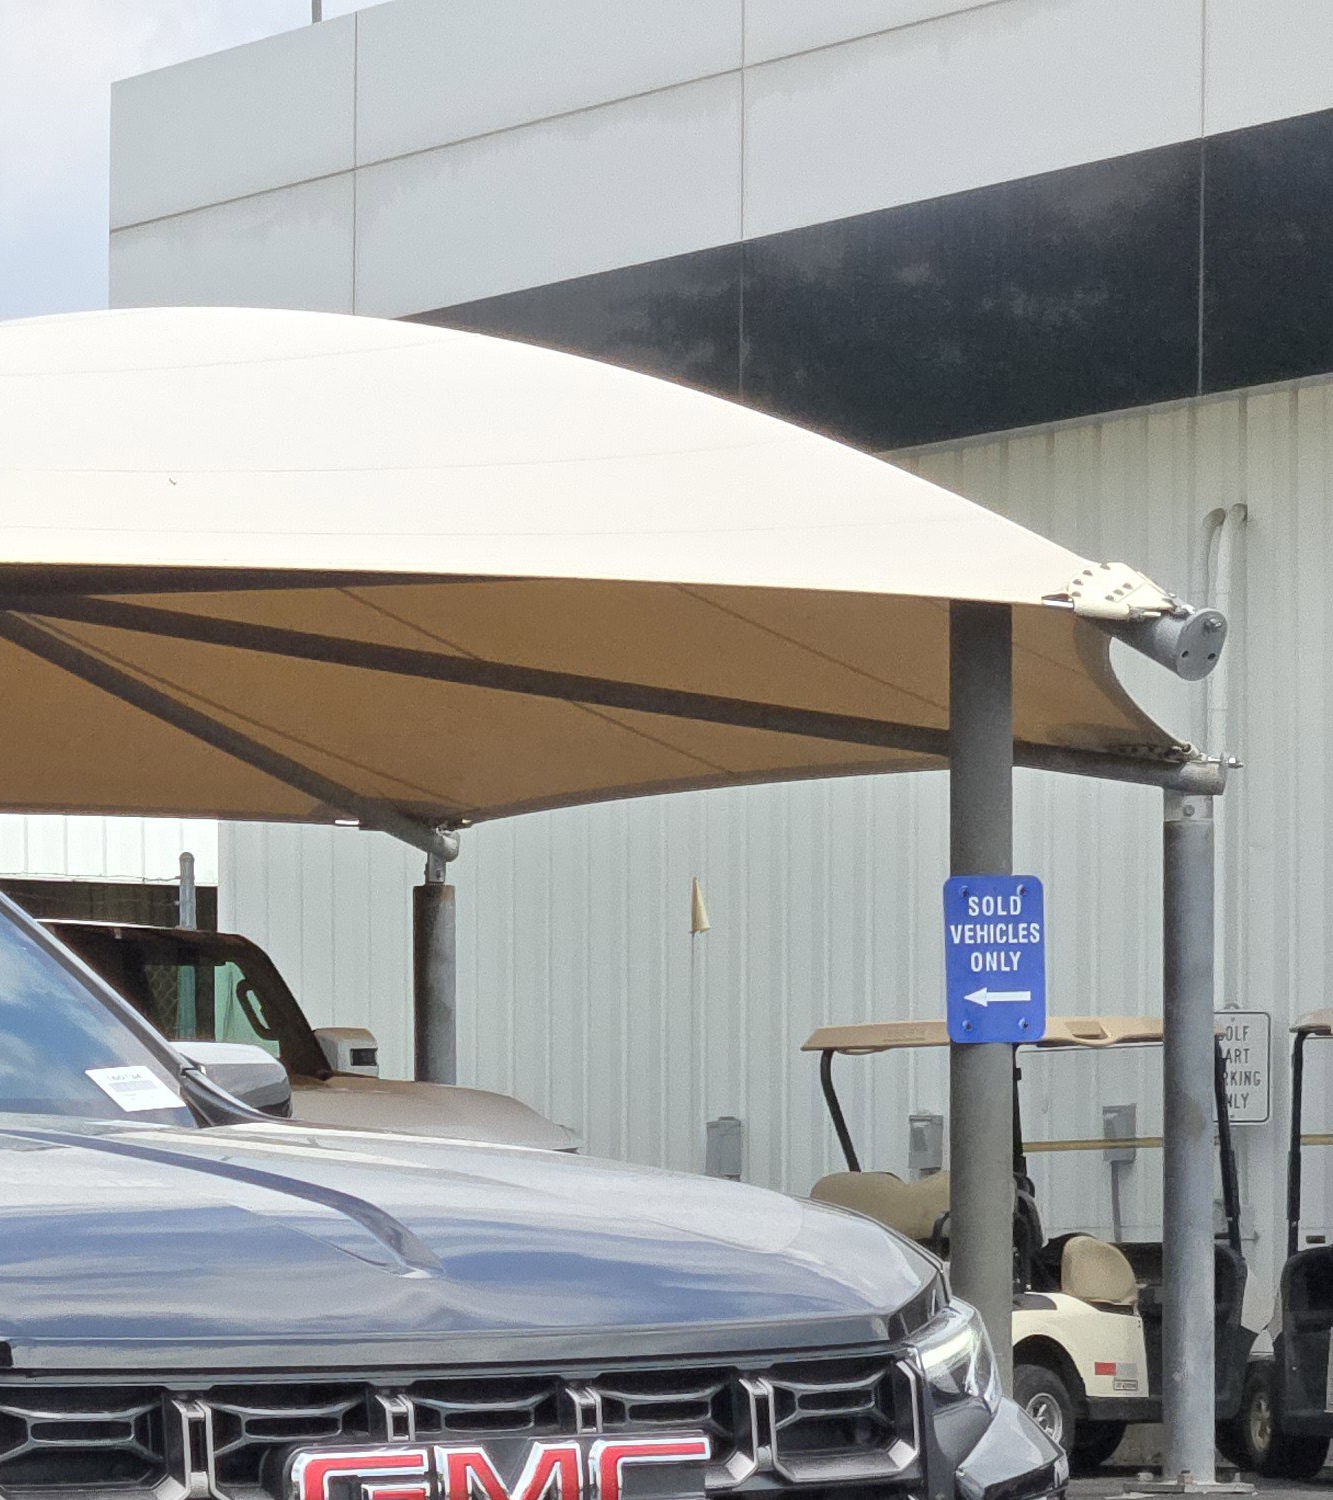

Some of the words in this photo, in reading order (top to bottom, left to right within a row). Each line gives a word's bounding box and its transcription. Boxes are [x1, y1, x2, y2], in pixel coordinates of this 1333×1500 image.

[968, 896, 1022, 916] SOLD
[949, 923, 1040, 944] VEHICLES
[970, 951, 1021, 972] ONLY
[1225, 1048, 1250, 1064] ART
[1223, 1071, 1261, 1086] RKING
[1227, 1093, 1249, 1109] NLY
